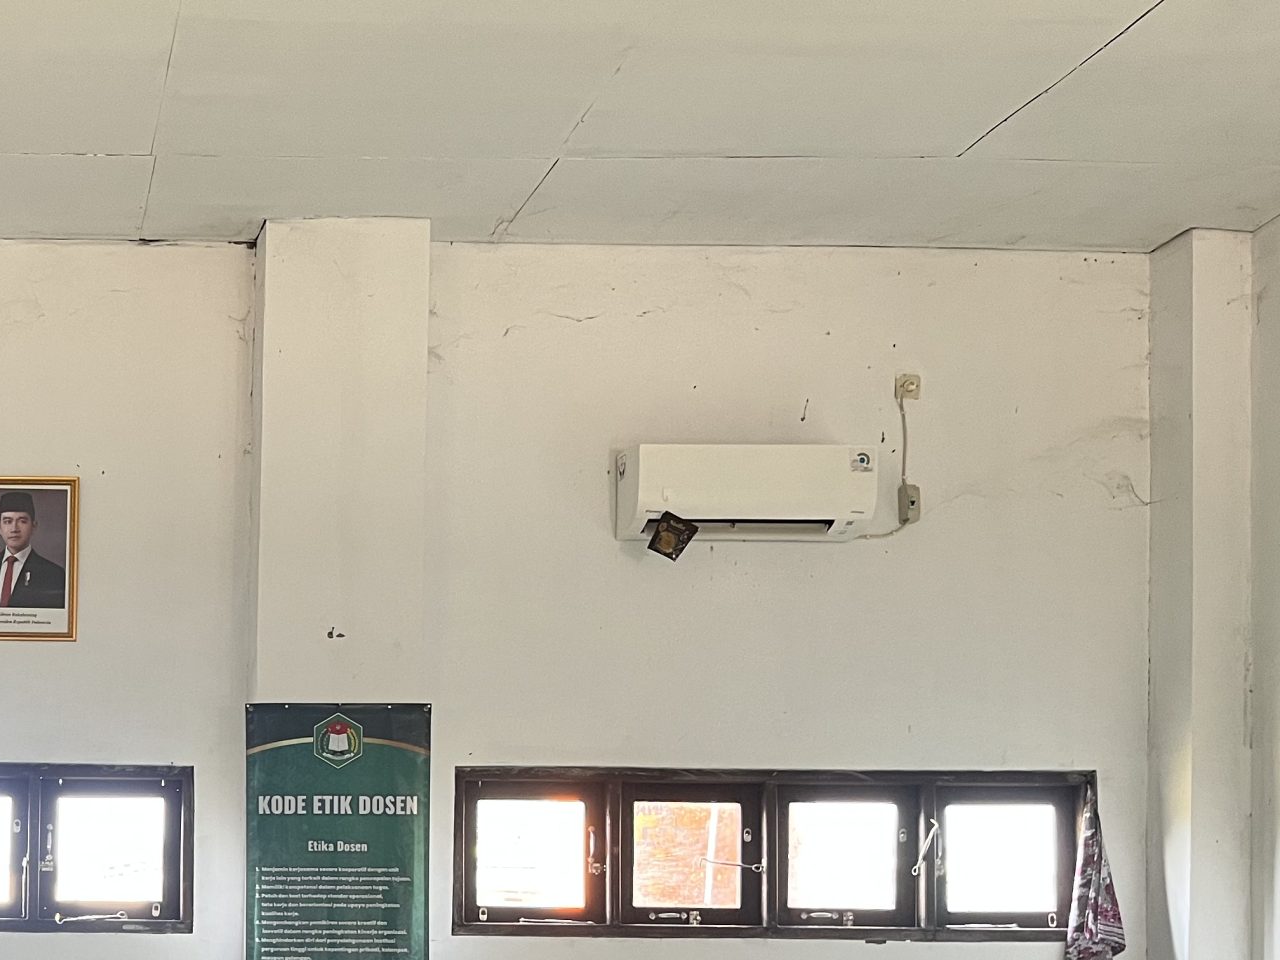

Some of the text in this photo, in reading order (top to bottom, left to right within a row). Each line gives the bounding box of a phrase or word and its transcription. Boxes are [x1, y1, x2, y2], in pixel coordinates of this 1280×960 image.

[258, 795, 418, 815] KODE ETIK DOSEN
[308, 840, 368, 852] Etika Dosen
